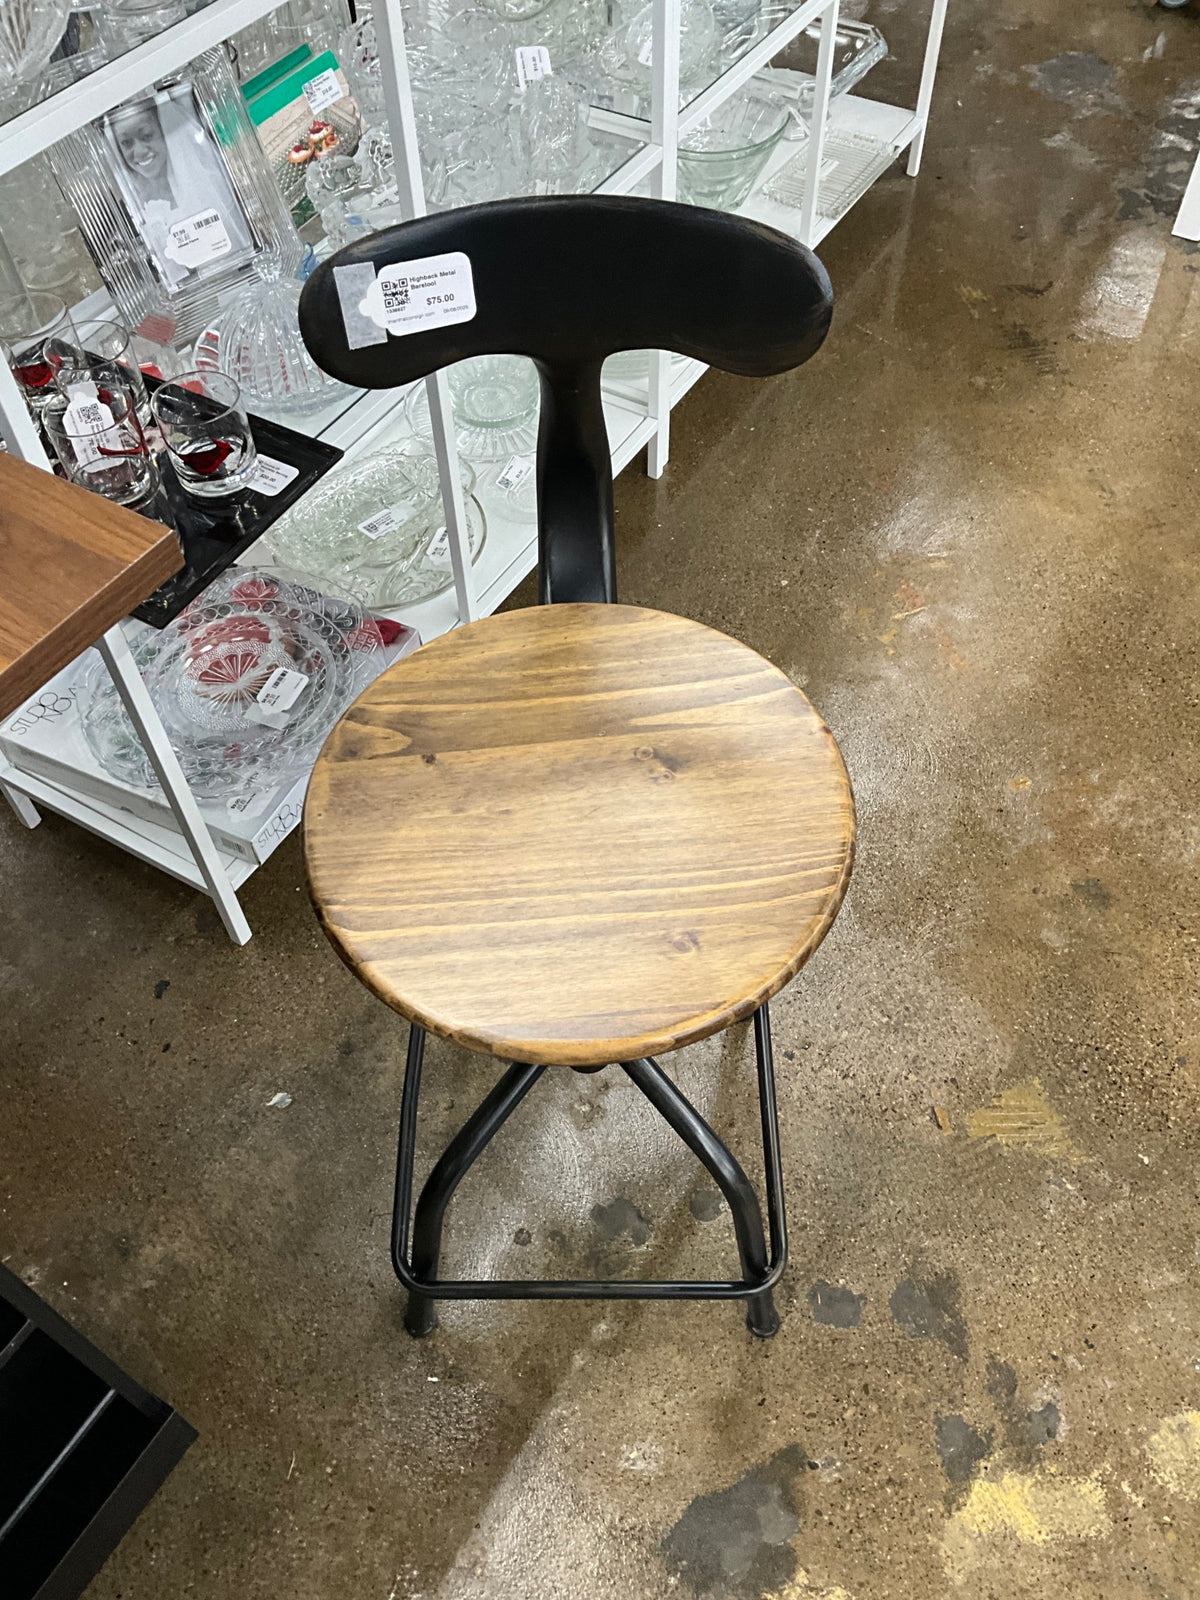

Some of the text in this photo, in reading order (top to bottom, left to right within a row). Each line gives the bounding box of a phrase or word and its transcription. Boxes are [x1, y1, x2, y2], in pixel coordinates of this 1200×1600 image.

[409, 269, 456, 283] Highback Metal
[410, 280, 437, 290] Barstool
[426, 293, 455, 306] $75.00
